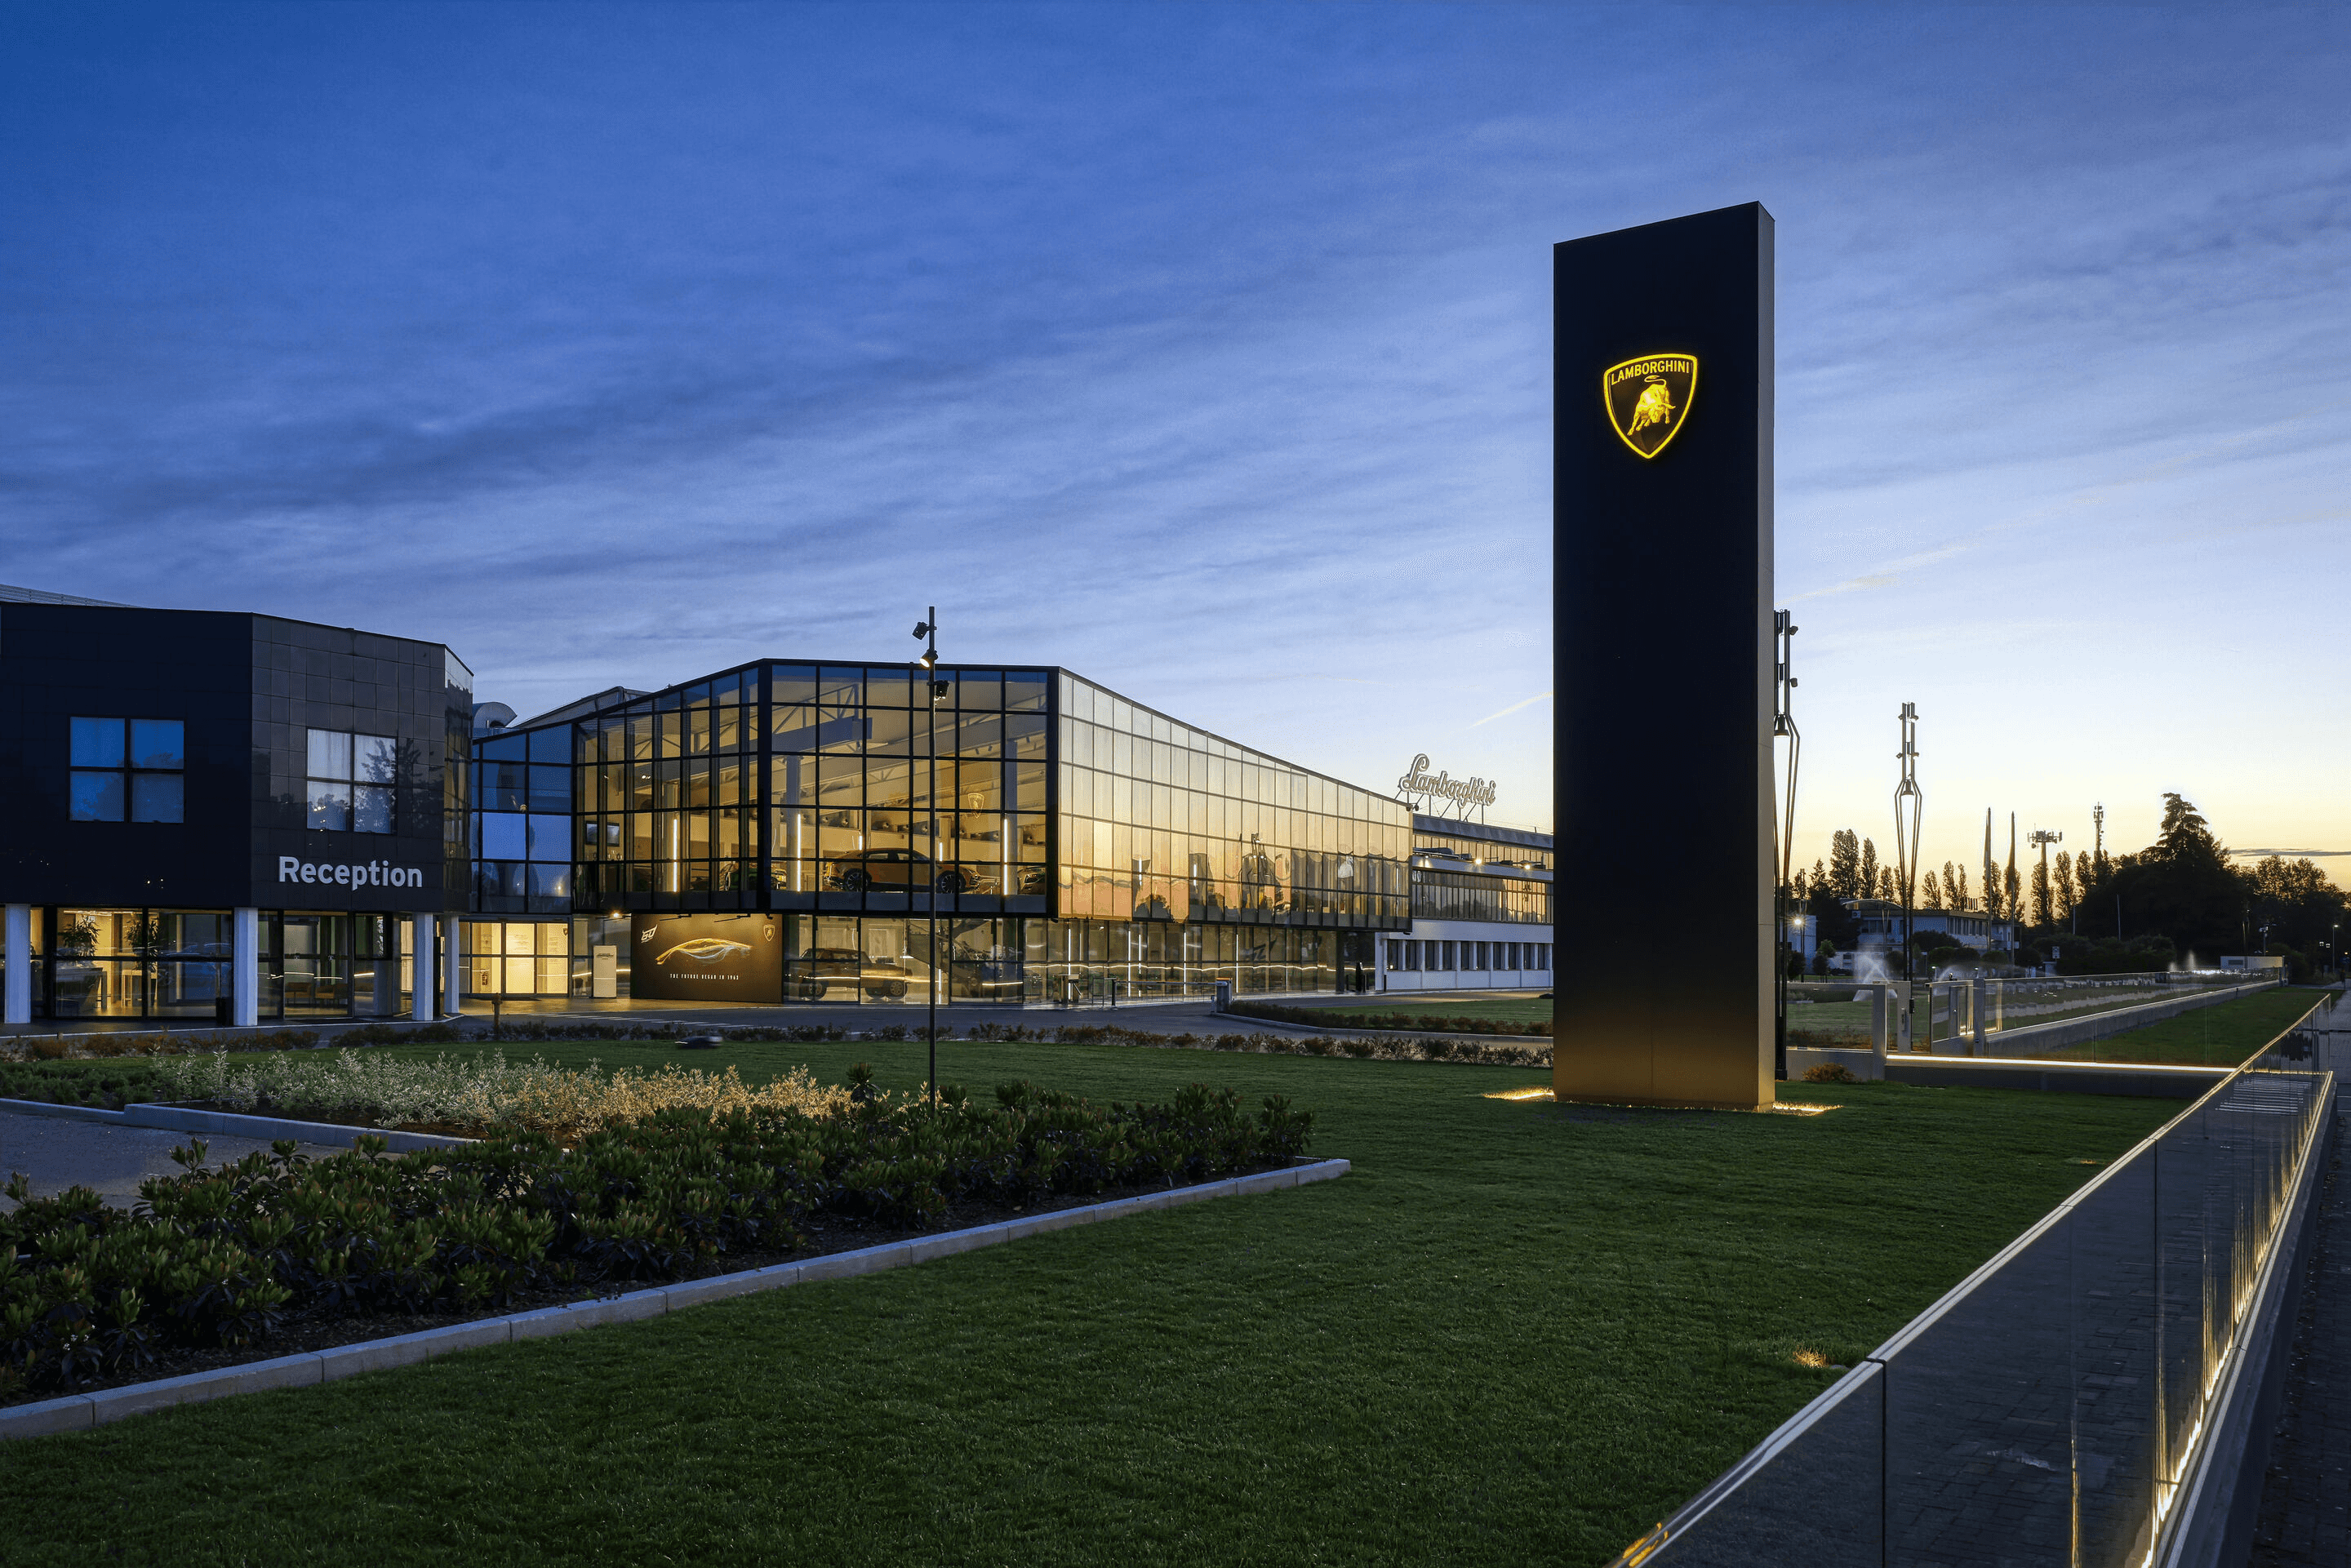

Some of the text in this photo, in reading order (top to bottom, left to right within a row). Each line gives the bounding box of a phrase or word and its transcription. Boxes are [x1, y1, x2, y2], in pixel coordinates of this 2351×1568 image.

[1611, 360, 1690, 385] LAMBORGHINI
[1398, 753, 1497, 810] Lamborghini
[278, 855, 423, 891] Reception
